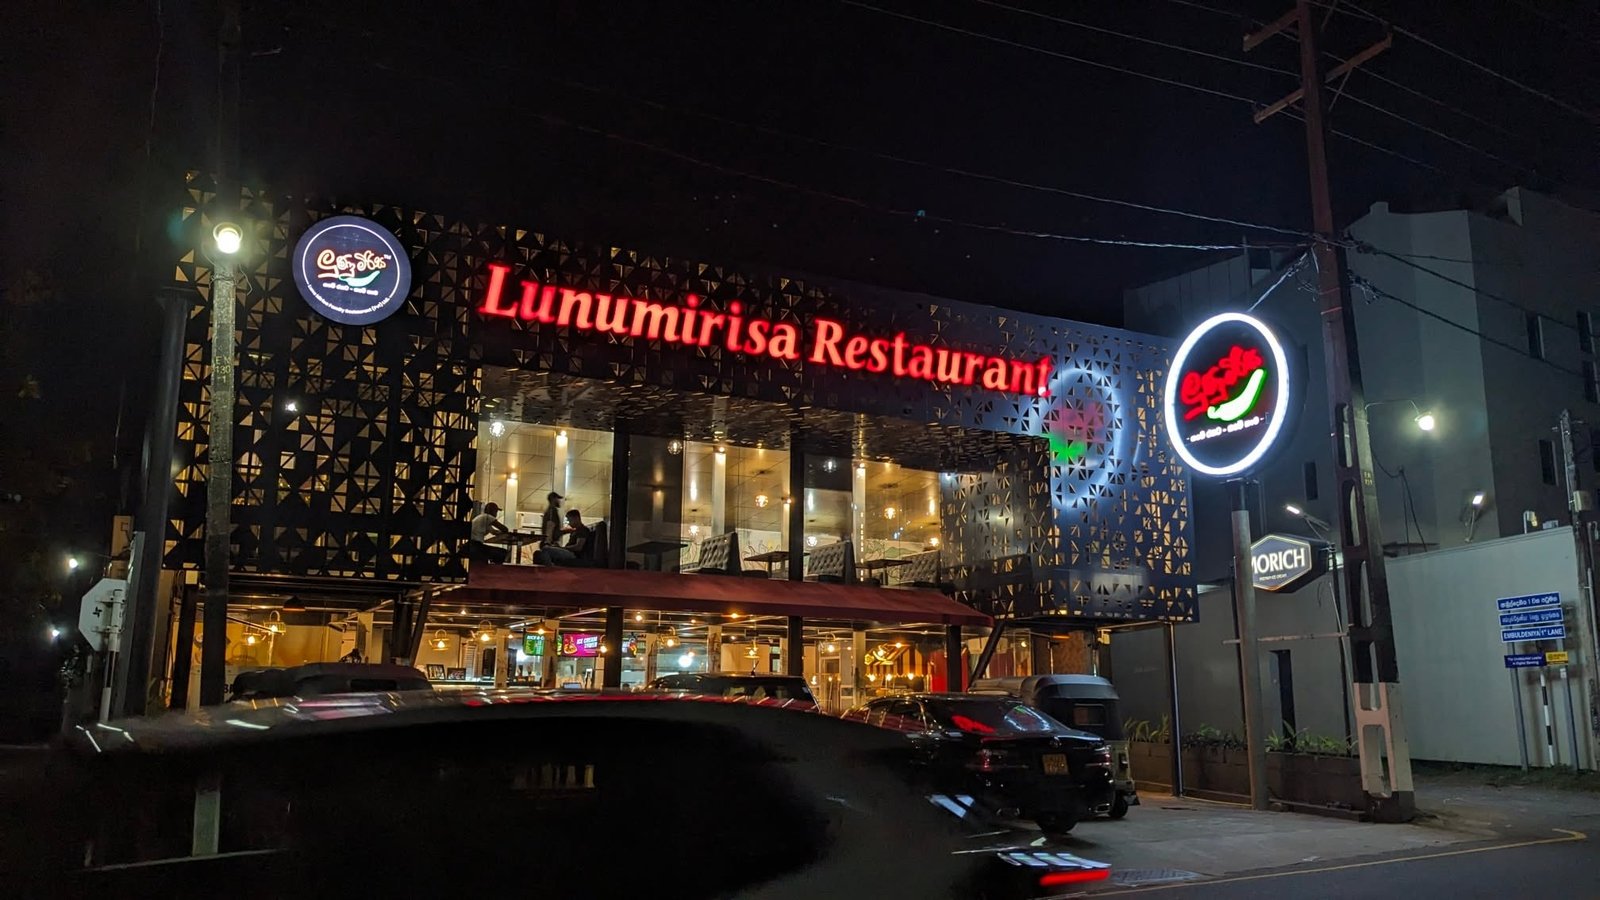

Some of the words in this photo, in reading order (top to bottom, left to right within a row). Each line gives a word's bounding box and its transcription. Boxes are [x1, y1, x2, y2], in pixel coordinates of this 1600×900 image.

[478, 264, 798, 359] Lunumirisa
[809, 319, 1053, 397] Restaurant
[1503, 630, 1540, 639] EMBULDENIYA
[1547, 628, 1563, 636] LANE
